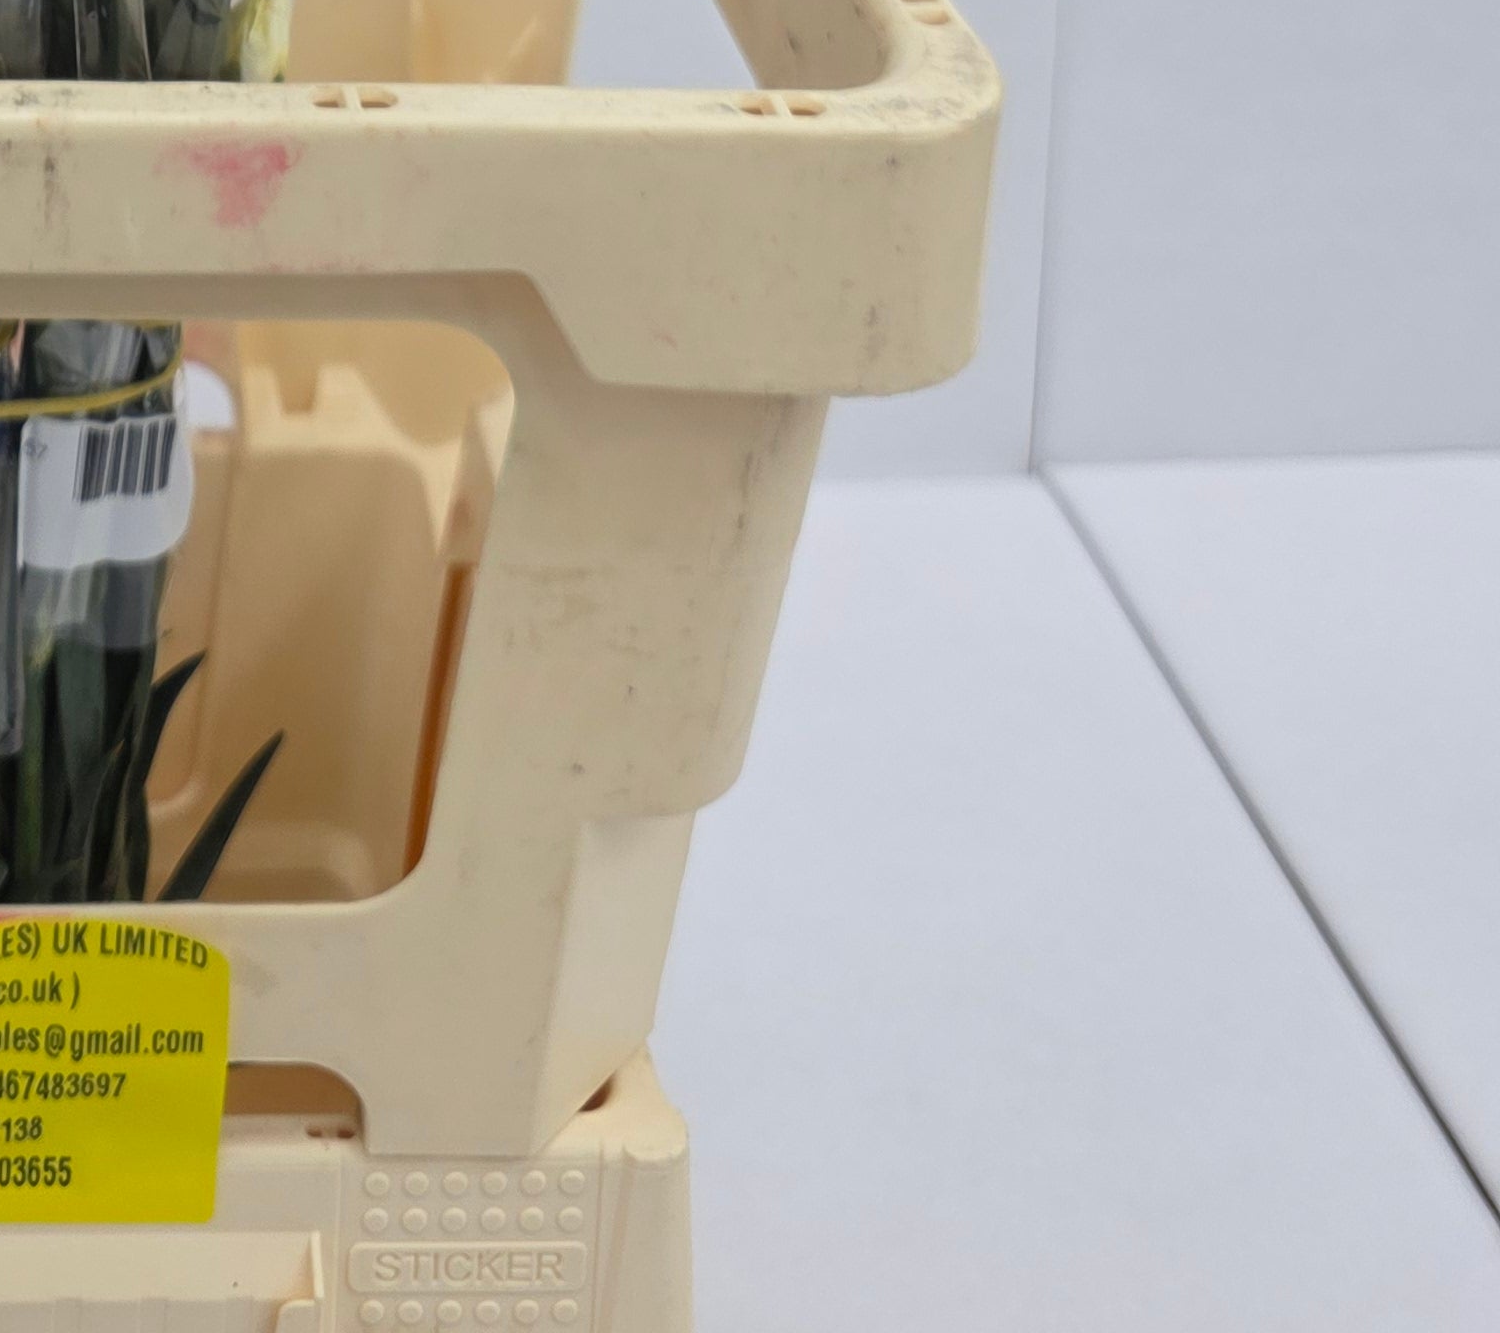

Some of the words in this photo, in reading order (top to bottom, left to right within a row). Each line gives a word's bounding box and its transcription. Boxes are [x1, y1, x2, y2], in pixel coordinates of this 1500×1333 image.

[52, 921, 88, 956] UK
[99, 922, 209, 970] LIMITED
[373, 1250, 567, 1283] STICKER
